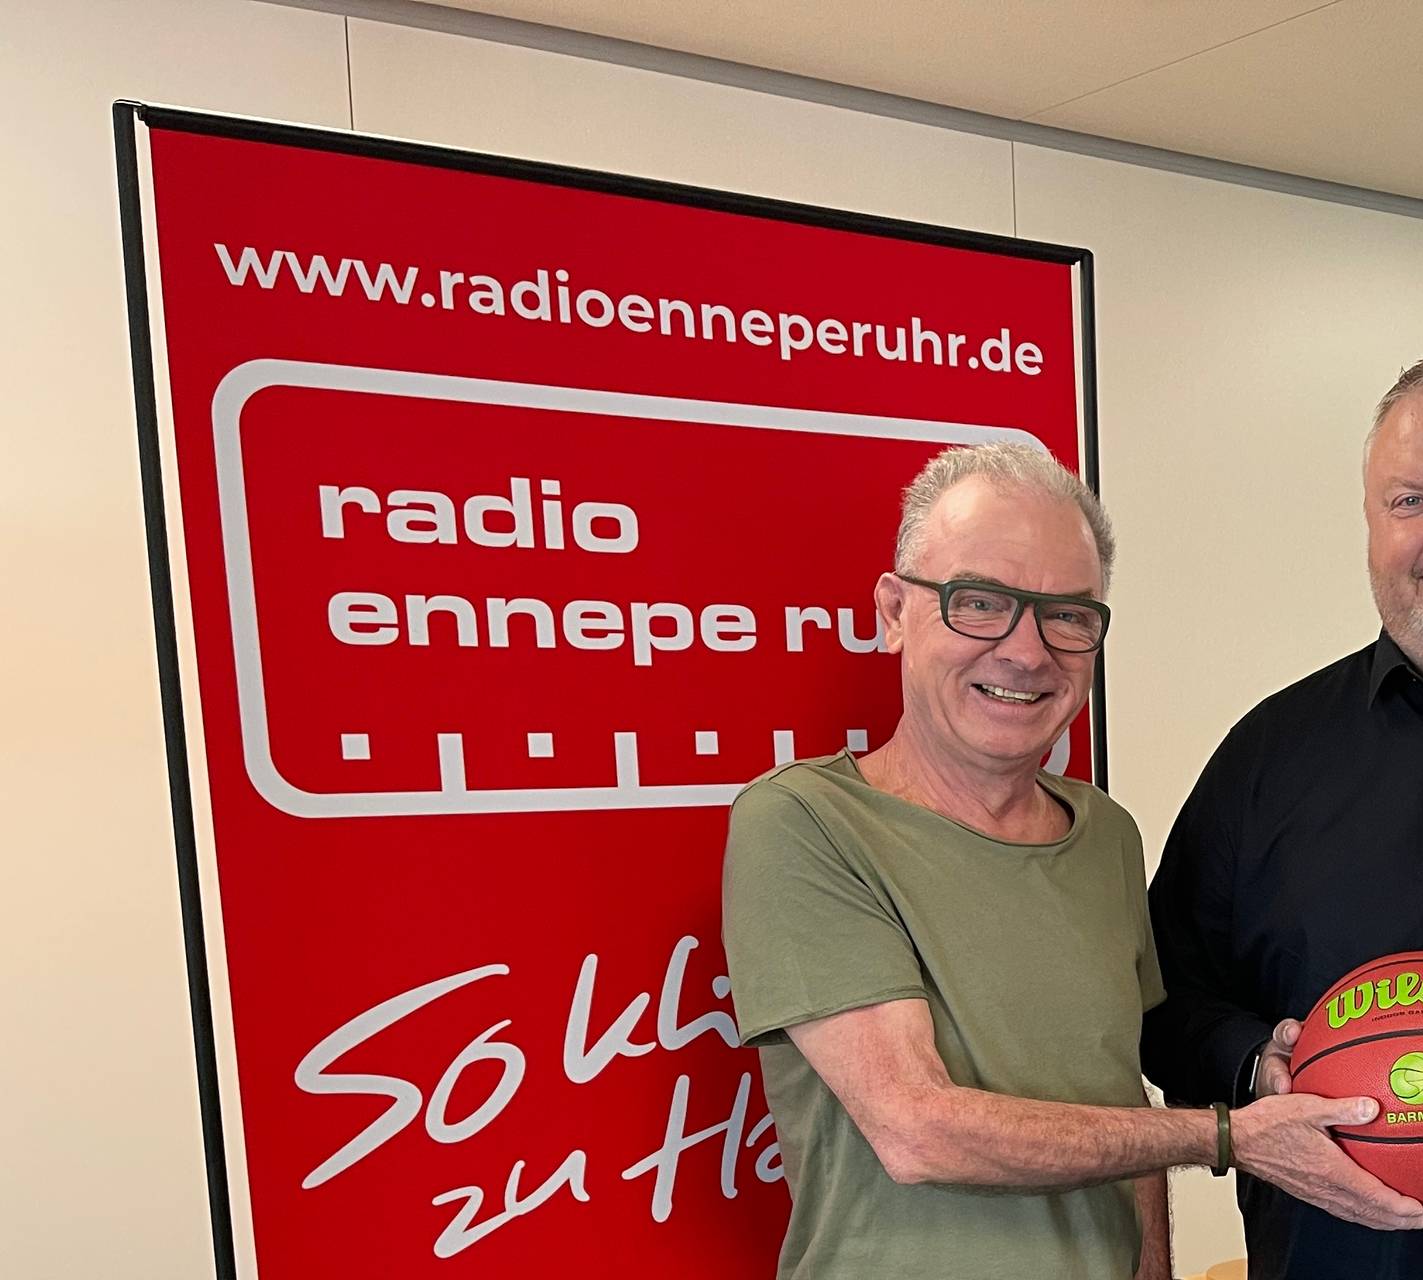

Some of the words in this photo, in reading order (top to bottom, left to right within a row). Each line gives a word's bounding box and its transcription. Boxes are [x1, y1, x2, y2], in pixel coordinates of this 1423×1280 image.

[214, 243, 1044, 376] www.radioenneperuhr.de
[318, 476, 640, 555] radio
[327, 591, 757, 667] ennepe
[1372, 1011, 1406, 1022] INDOOR
[295, 964, 526, 1190] So
[432, 1150, 590, 1259] zu
